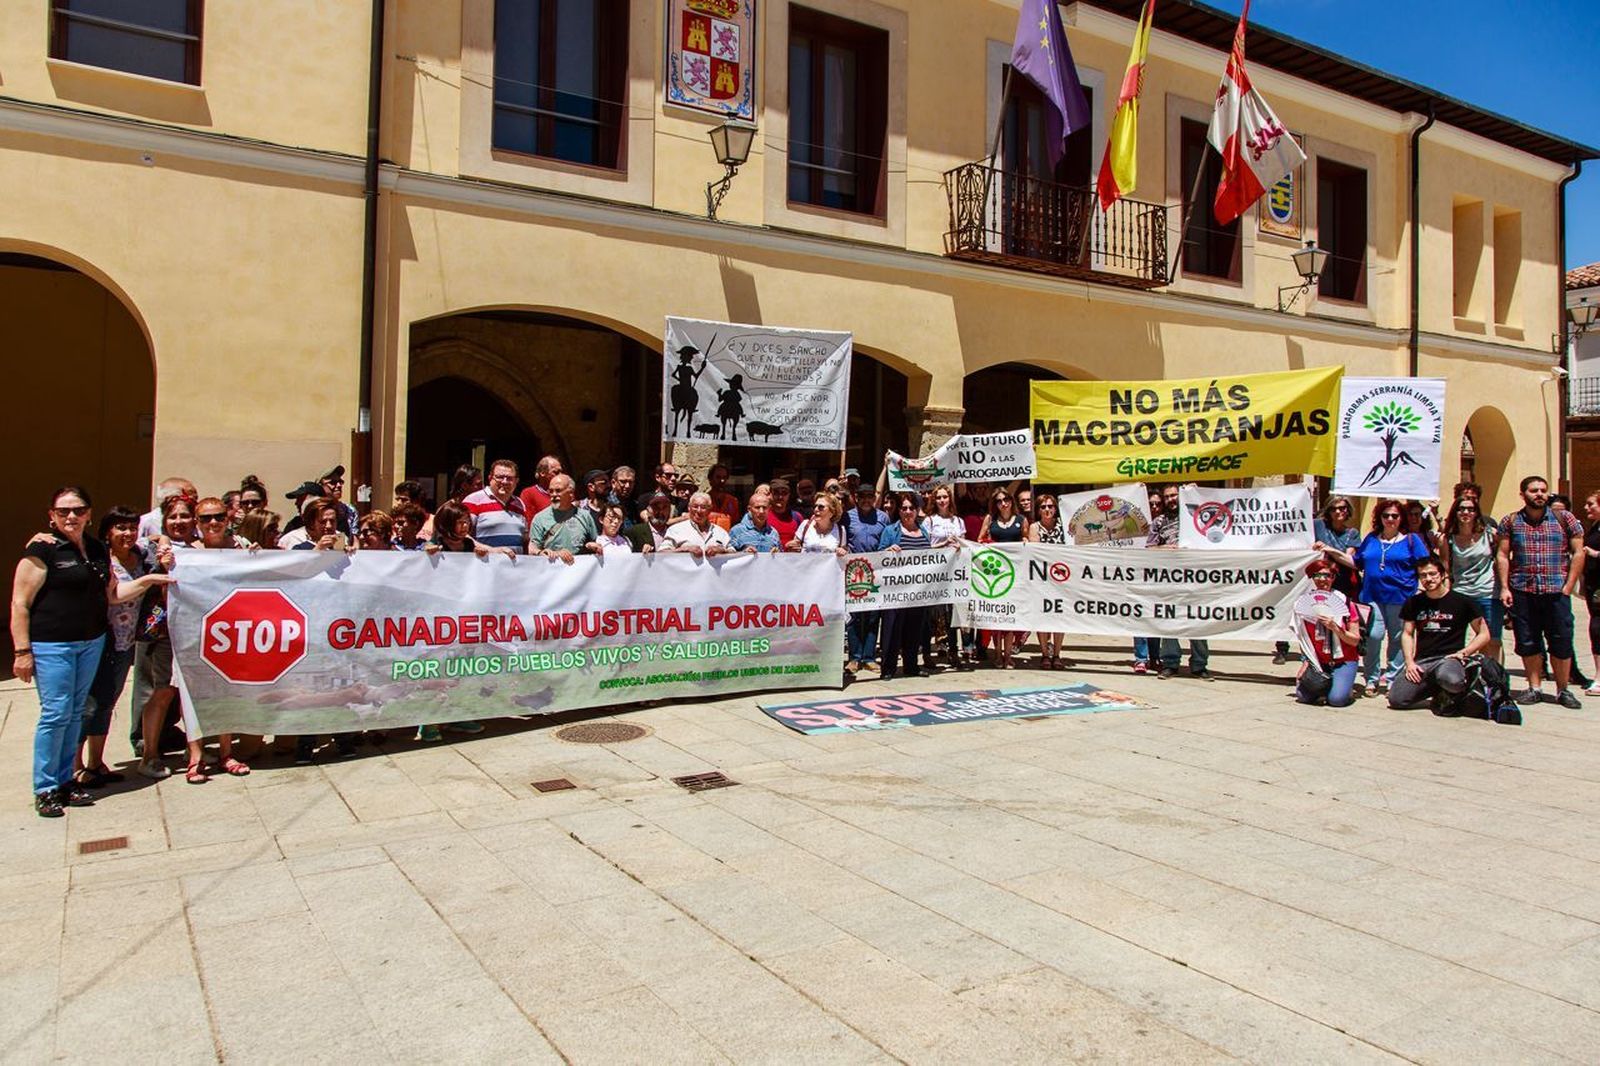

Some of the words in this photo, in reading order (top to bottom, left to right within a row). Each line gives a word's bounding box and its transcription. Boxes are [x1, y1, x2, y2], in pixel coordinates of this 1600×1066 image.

[737, 354, 754, 362] QUE
[760, 355, 772, 363] EN
[753, 344, 783, 354] DICES
[789, 345, 827, 356] SANCHO
[1109, 389, 1159, 415] NO
[1172, 380, 1250, 413] MÁS
[775, 407, 795, 415] SOLO
[1342, 394, 1369, 439] PLATAFORMA
[1369, 385, 1413, 398] SERRANÍA
[1413, 392, 1438, 415] LIMPIA
[1432, 424, 1441, 443] VIVA
[1033, 409, 1330, 445] MACROGRANJAS
[946, 443, 960, 451] POR
[972, 434, 1027, 447] FUTURO
[958, 450, 986, 464] NO
[1116, 452, 1248, 478] GREENPEACE
[948, 465, 1032, 480] MACROGRANJAS
[1236, 498, 1261, 511] NO
[1263, 502, 1271, 511] A
[1274, 500, 1288, 510] LA
[1231, 507, 1306, 524] GANADERÍA
[1231, 522, 1308, 536] INTENSIVA
[881, 552, 948, 567] GANADERÍA
[1081, 566, 1093, 580] A
[1103, 566, 1135, 581] LAS
[1143, 568, 1295, 585] MACROGRANJAS
[954, 588, 969, 598] NO
[968, 600, 976, 611] El
[979, 601, 1016, 615] Horcajo
[1043, 599, 1063, 613] DE
[1074, 601, 1143, 618] CERDOS
[1154, 604, 1176, 619] EN
[1187, 604, 1276, 621] LUCILLOS
[327, 614, 527, 650] GANADERIA
[533, 606, 701, 641] INDUSTRIAL
[708, 602, 825, 631] PORCINA
[210, 618, 301, 654] STOP
[391, 658, 440, 680] POR
[446, 654, 501, 677] UNOS
[506, 649, 586, 673] PUEBLOS
[590, 645, 642, 666] VIVOS
[647, 643, 659, 662] Y
[661, 637, 771, 660] SALUDABLES
[599, 678, 645, 690] CONVOCA:
[645, 670, 700, 686] ASOCIACIÓN
[740, 666, 770, 677] UNIDOS
[771, 666, 783, 675] DE
[784, 664, 821, 675] ZAMORA
[775, 694, 947, 727] STOP
[929, 700, 1084, 720] INDUSTRIAL
